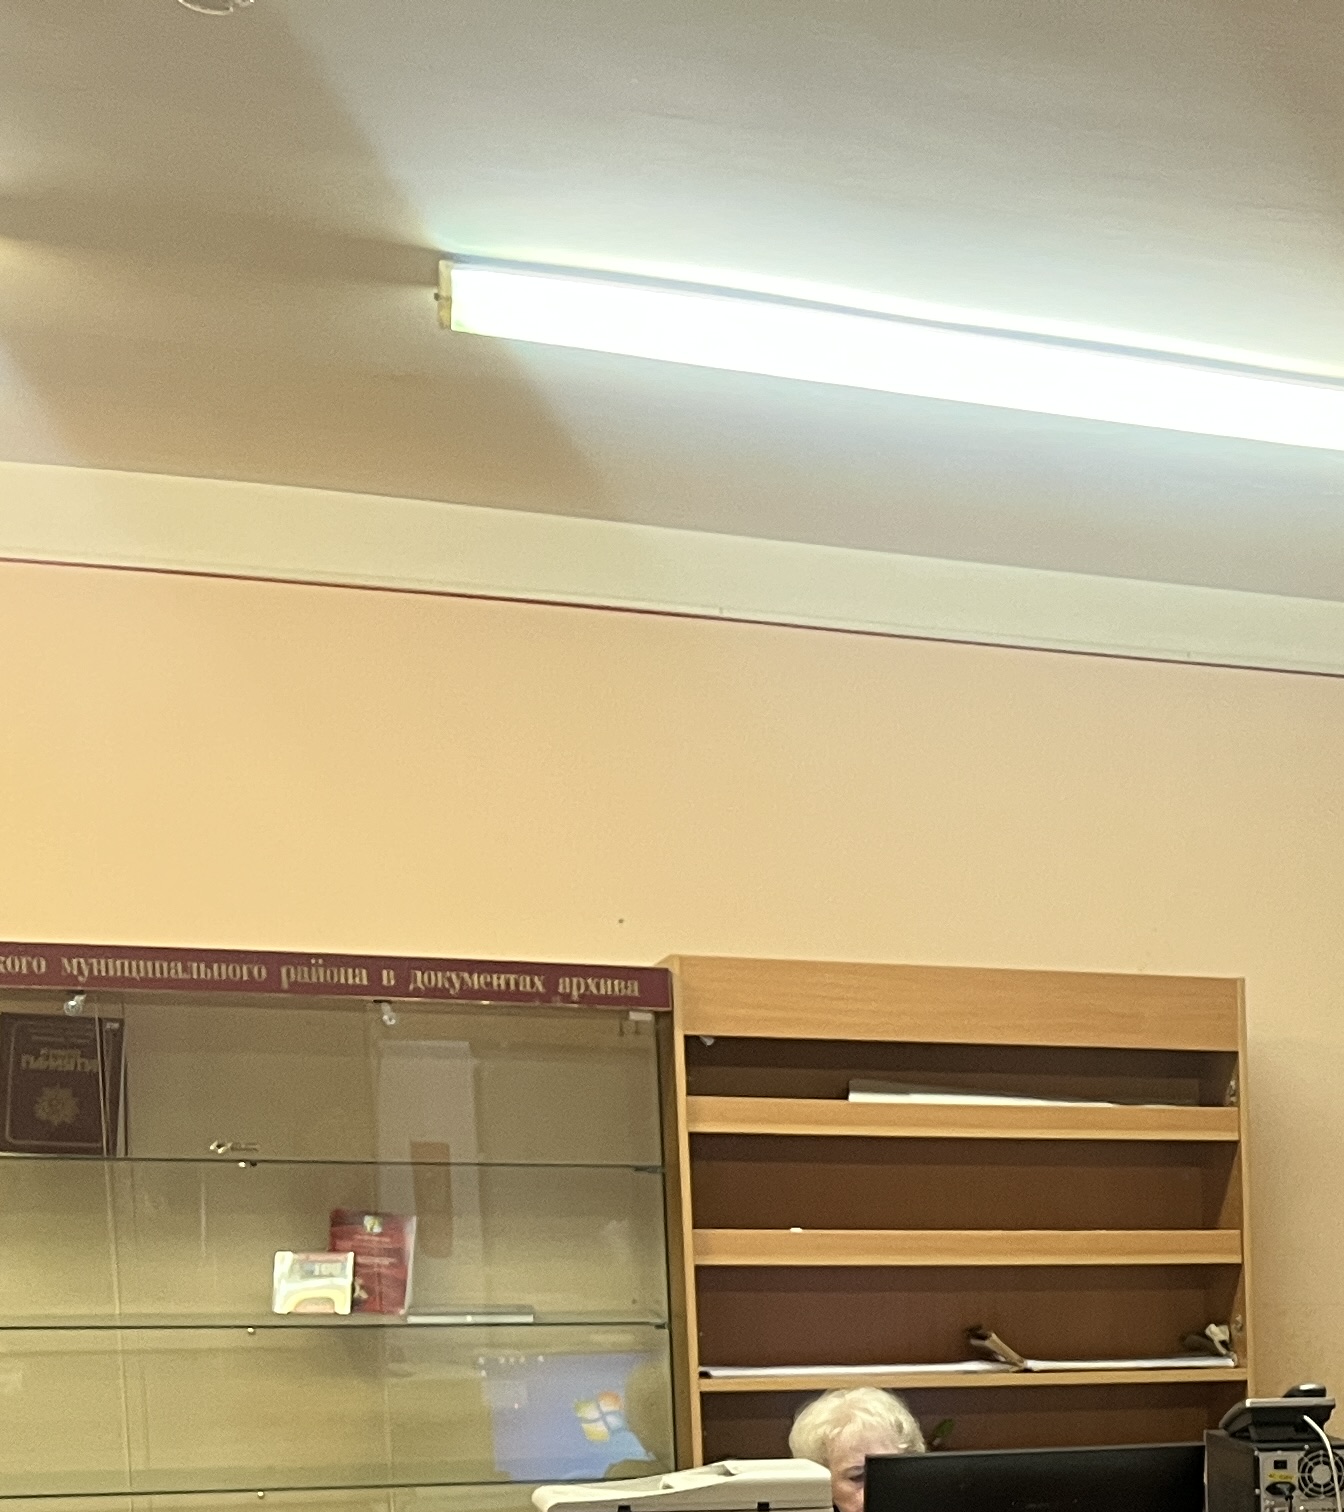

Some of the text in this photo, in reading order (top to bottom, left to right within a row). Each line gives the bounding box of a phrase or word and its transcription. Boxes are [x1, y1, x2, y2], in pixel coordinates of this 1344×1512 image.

[60, 957, 267, 983] муниципального
[280, 957, 368, 990] района
[381, 968, 396, 986] в
[408, 968, 546, 995] документах
[557, 975, 640, 1000] архива
